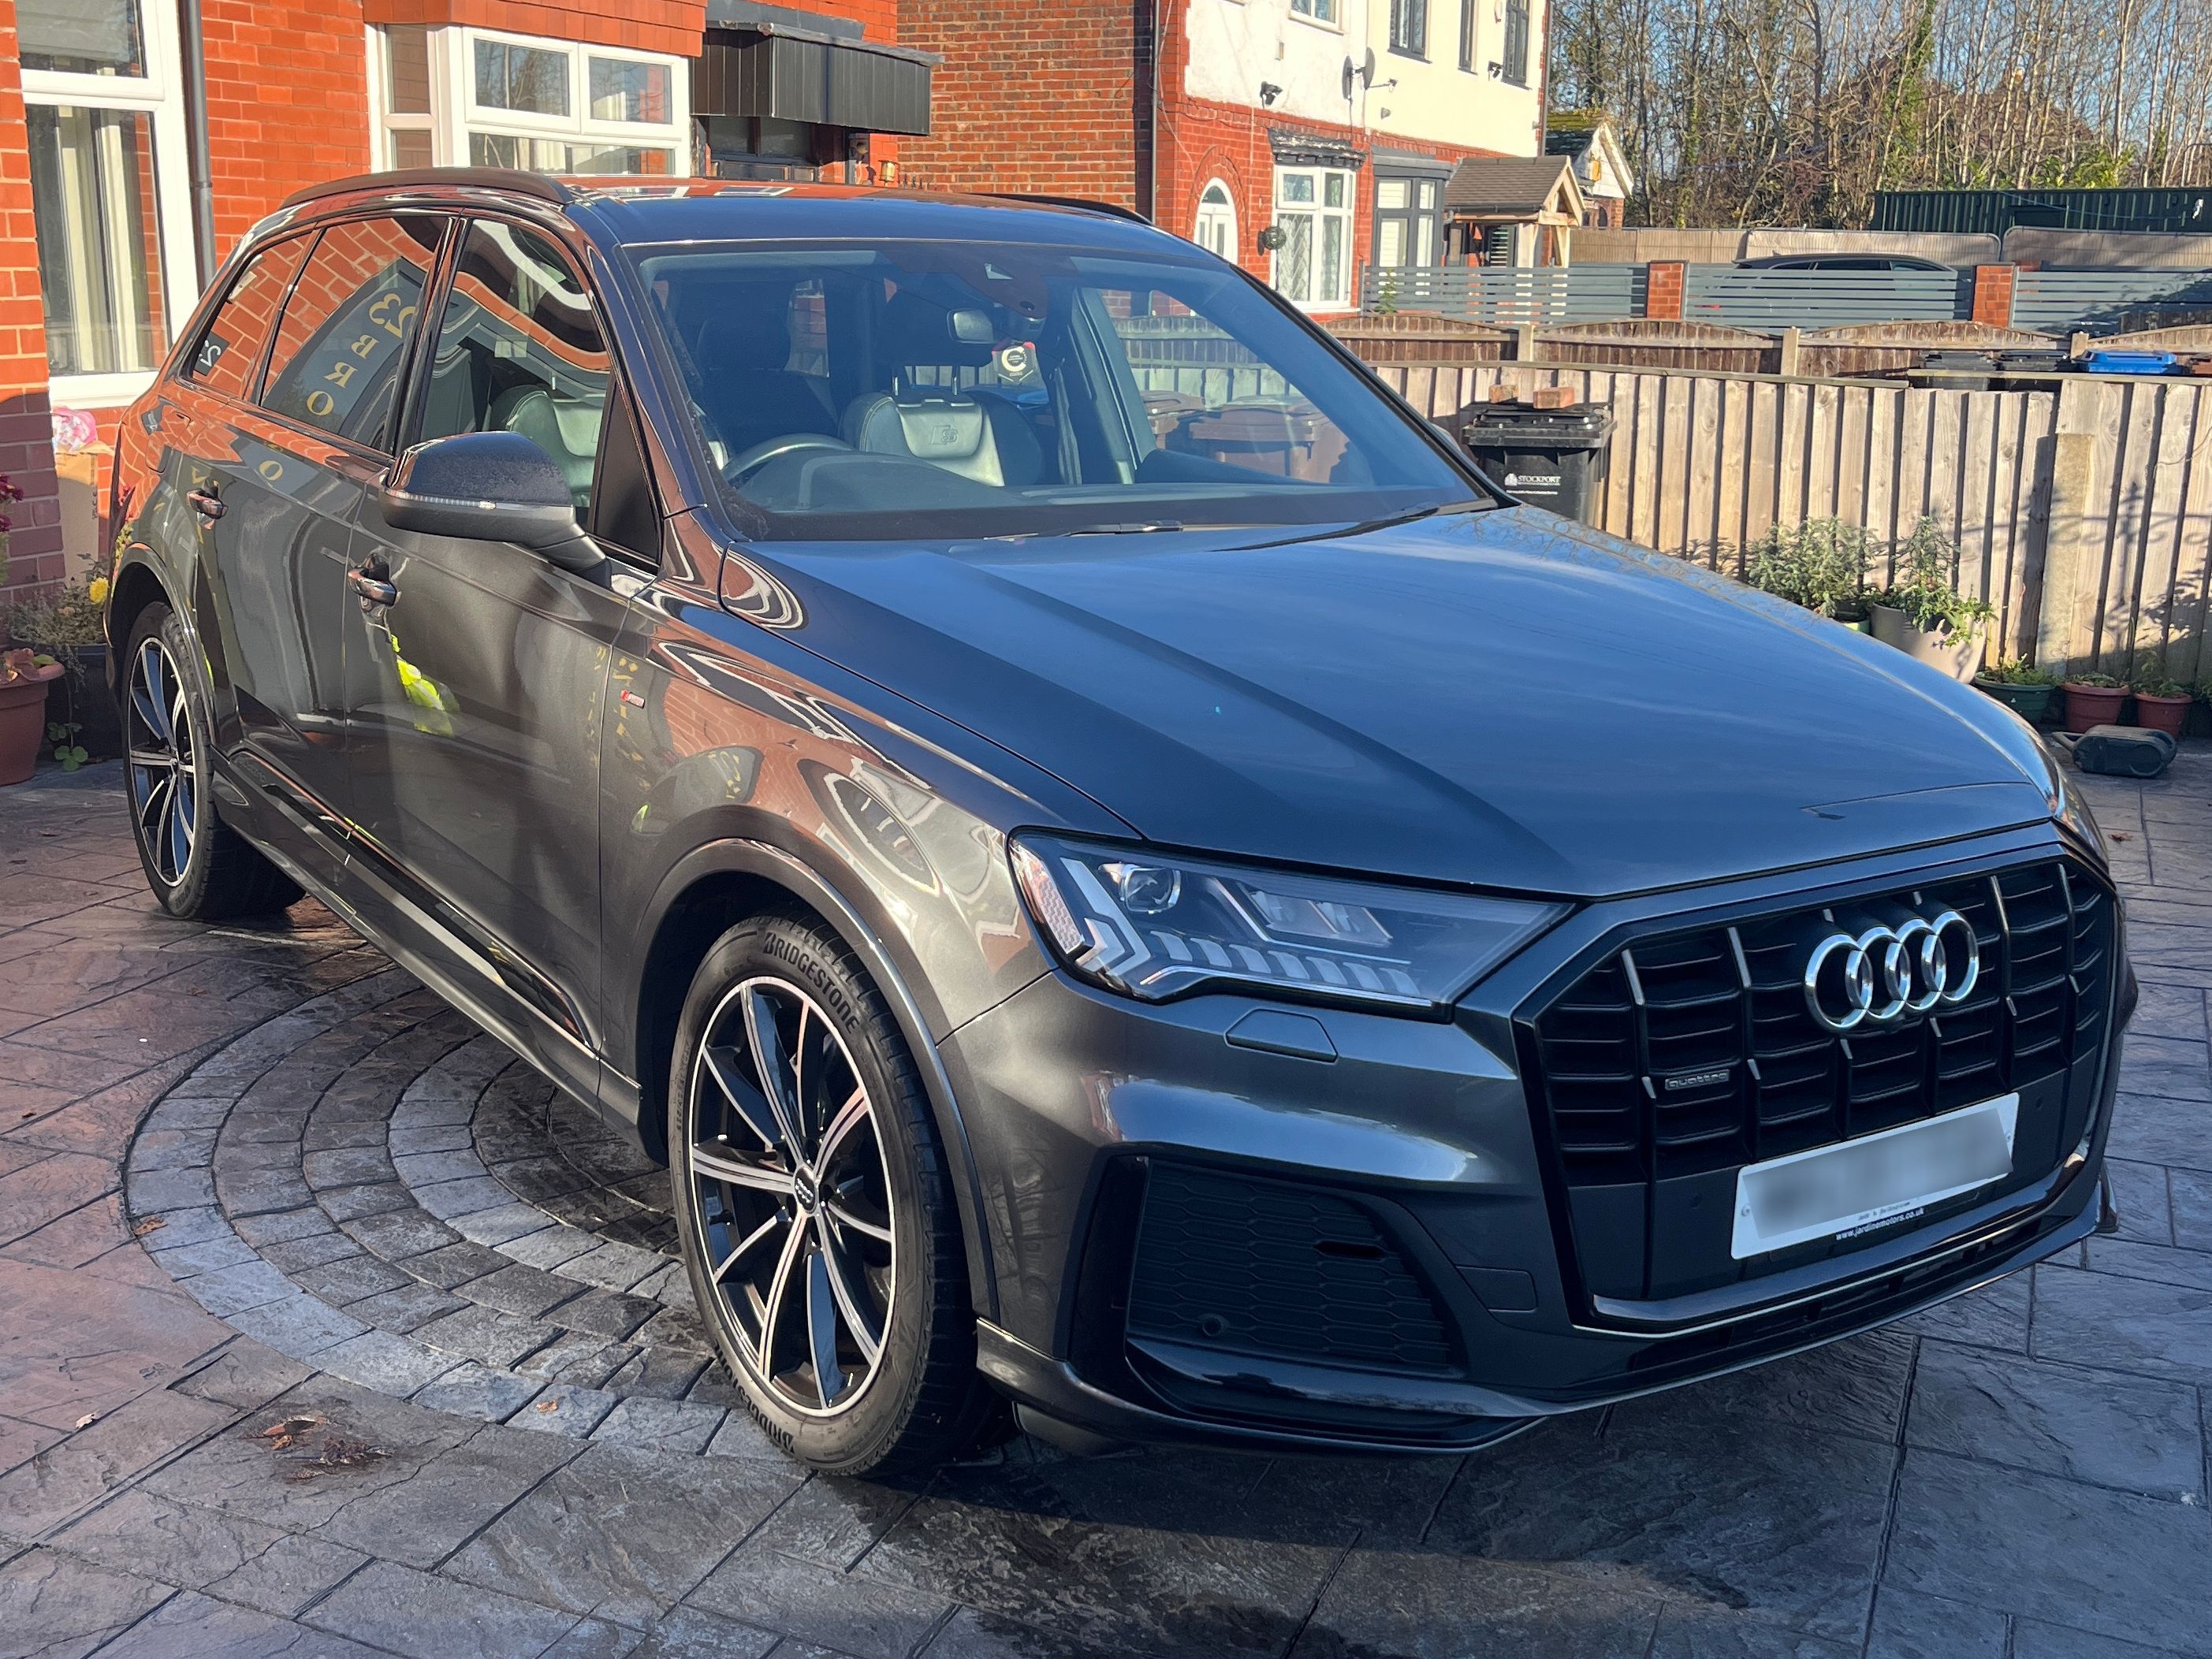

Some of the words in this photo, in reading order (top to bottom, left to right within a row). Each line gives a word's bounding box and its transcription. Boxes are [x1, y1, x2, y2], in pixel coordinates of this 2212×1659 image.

[1517, 474, 1561, 483] STOCKPORT
[762, 932, 860, 1035] BRIDGESTONE
[1668, 1072, 1727, 1088] quattro
